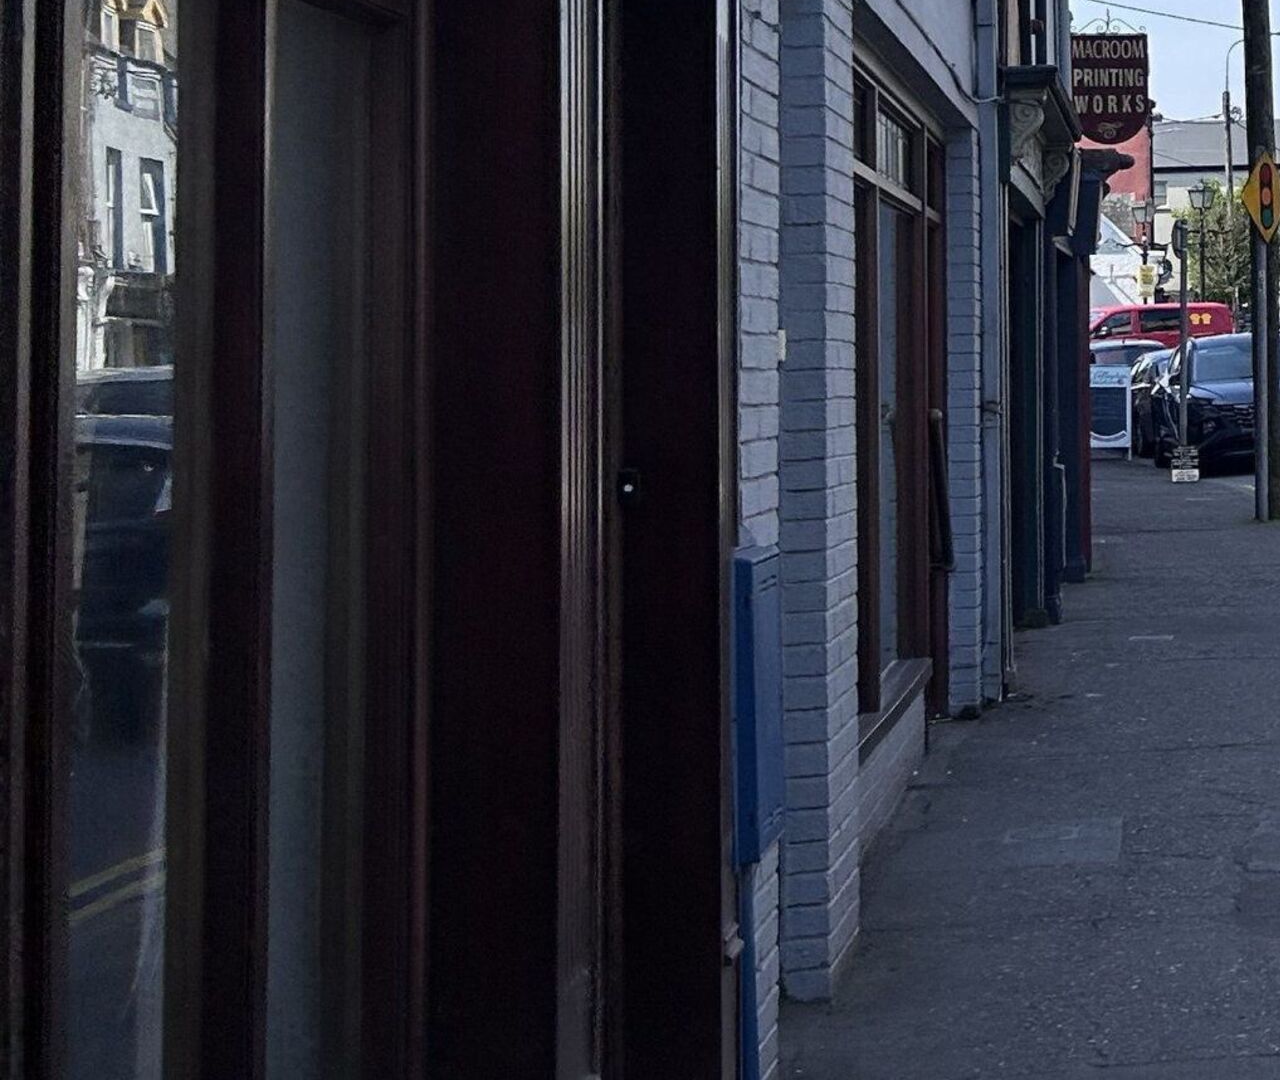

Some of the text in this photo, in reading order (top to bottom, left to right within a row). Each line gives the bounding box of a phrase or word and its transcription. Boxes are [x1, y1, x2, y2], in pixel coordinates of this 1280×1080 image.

[1072, 40, 1145, 59] MACROOM
[1073, 68, 1145, 87] PRINTING
[1074, 95, 1145, 114] WORKS
